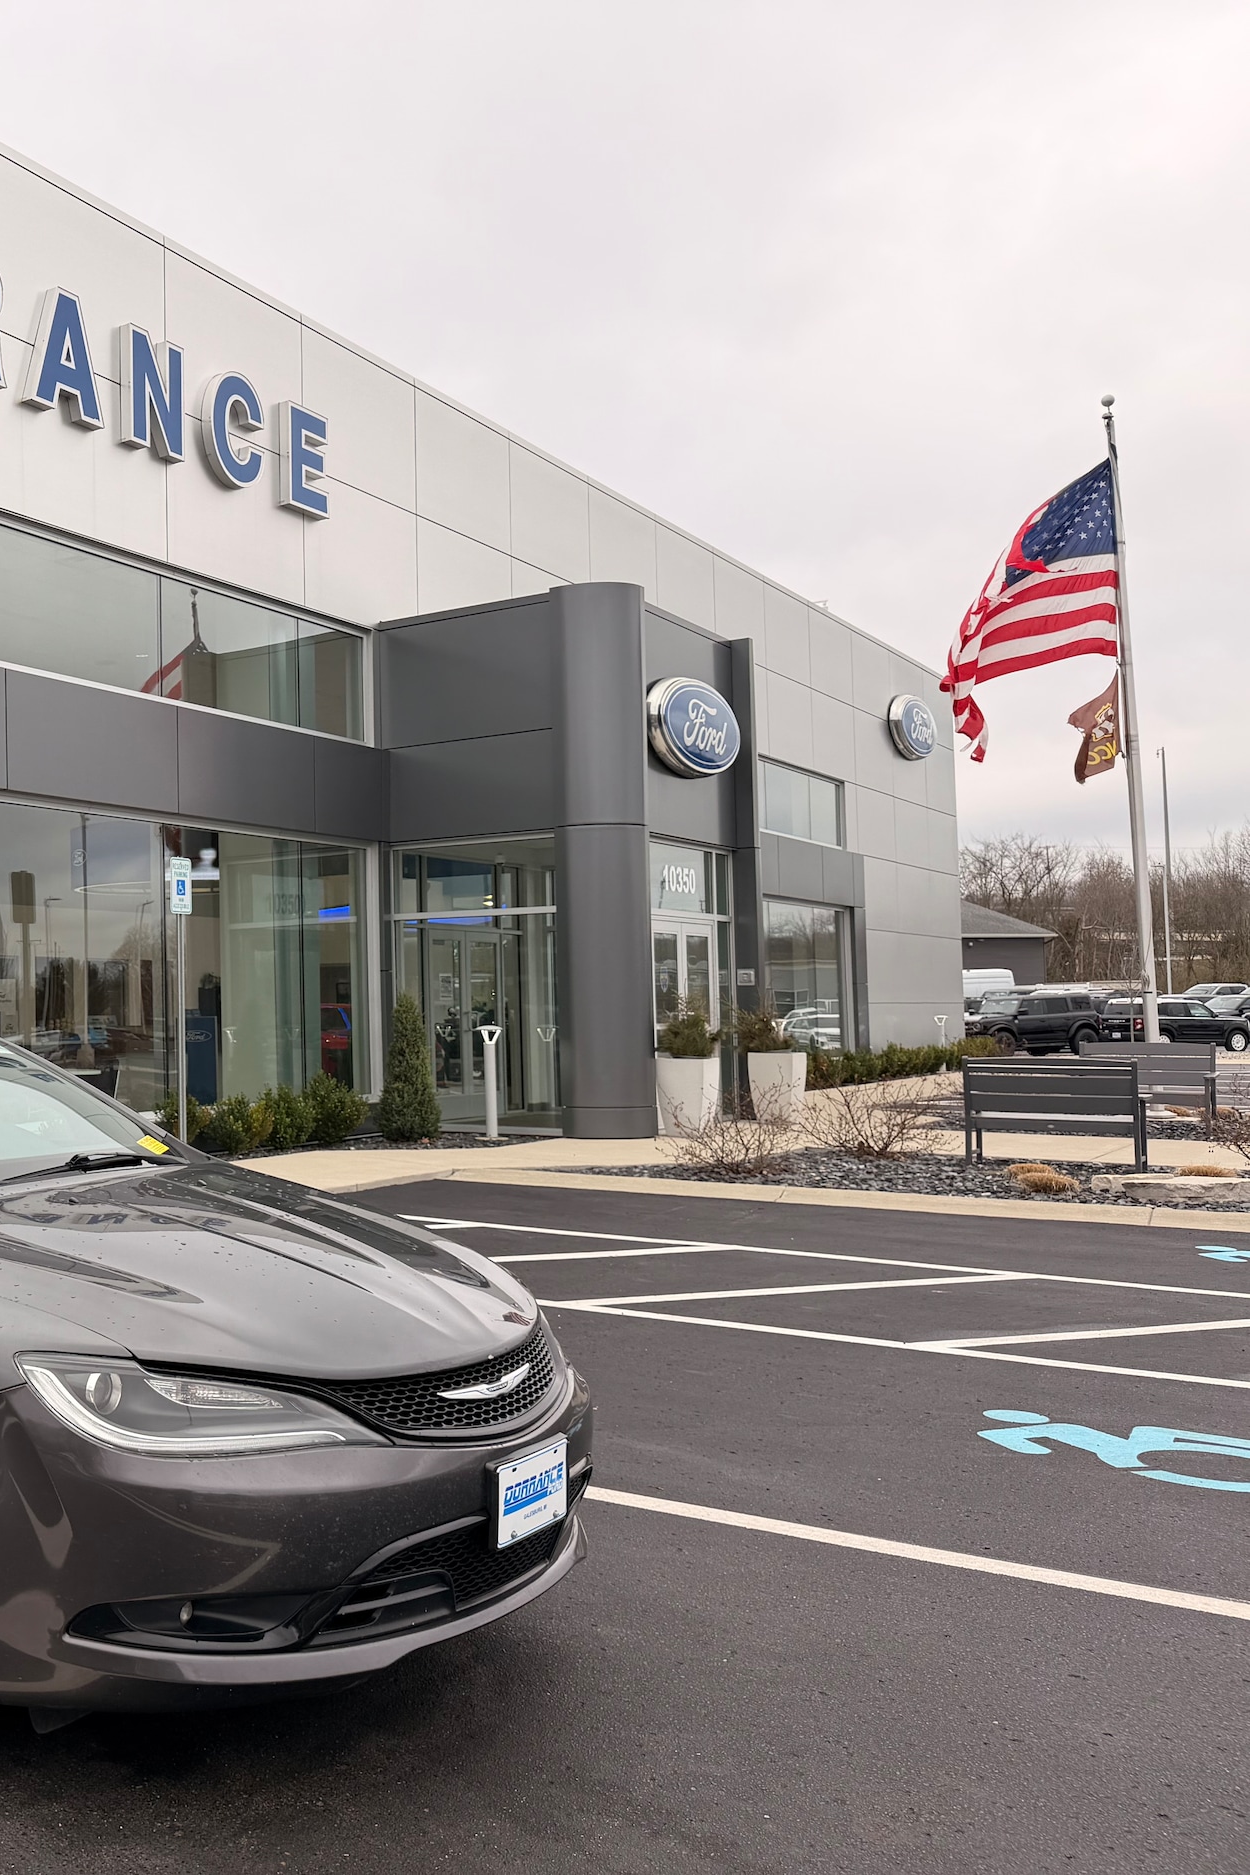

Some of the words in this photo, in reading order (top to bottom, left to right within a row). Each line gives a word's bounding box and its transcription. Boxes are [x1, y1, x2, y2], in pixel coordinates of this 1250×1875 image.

[683, 698, 727, 756] Ford
[911, 708, 934, 745] Ford
[662, 864, 696, 894] 10350
[503, 1461, 564, 1506] DORRANCE
